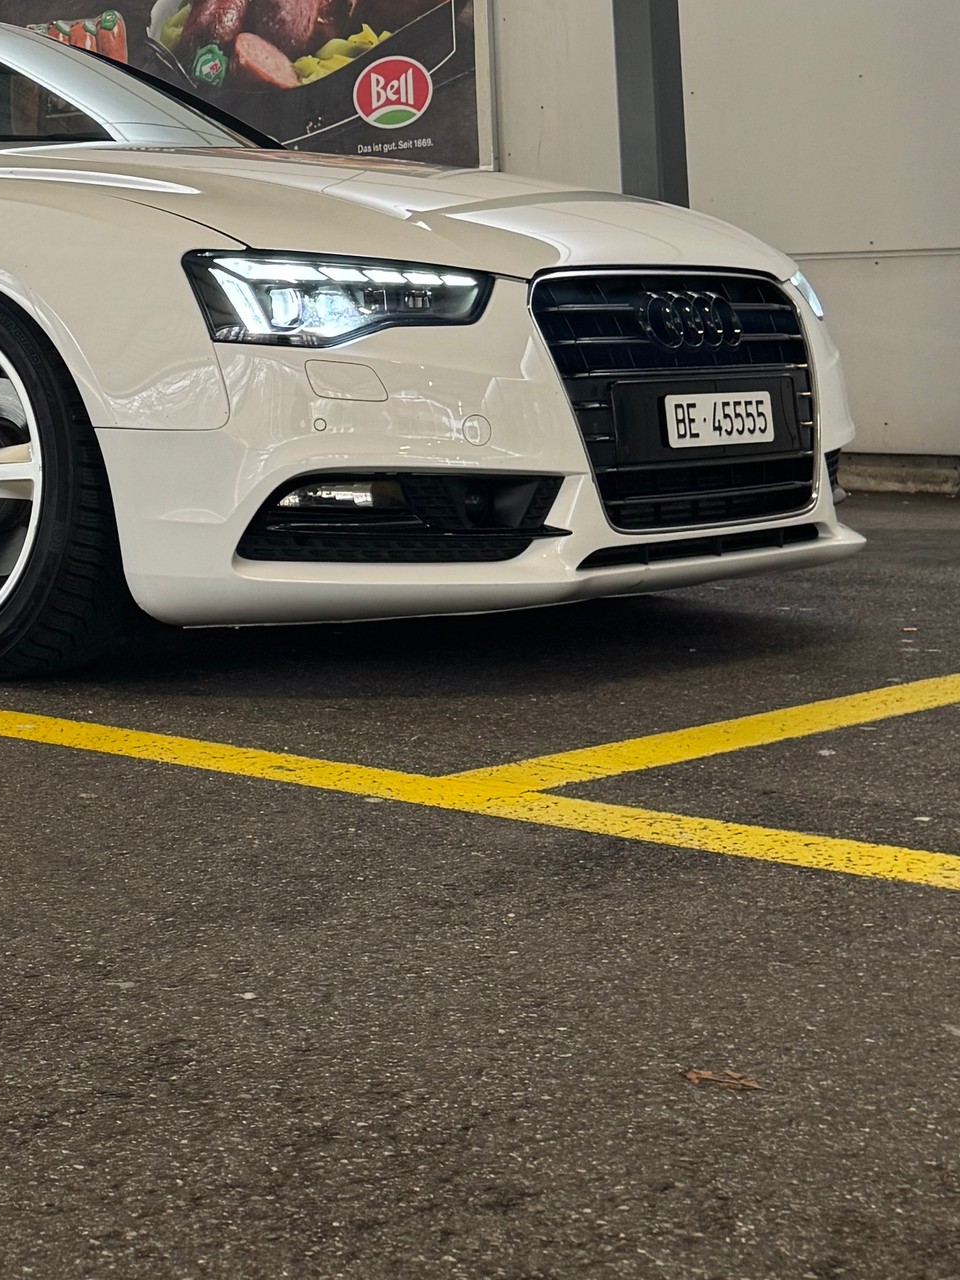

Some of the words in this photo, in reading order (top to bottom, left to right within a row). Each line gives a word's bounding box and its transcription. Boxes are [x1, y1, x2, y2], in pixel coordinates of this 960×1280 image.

[370, 67, 415, 110] Bell
[357, 144, 372, 154] Das
[372, 142, 382, 152] ist
[383, 141, 397, 153] gut.
[398, 139, 413, 150] Seit
